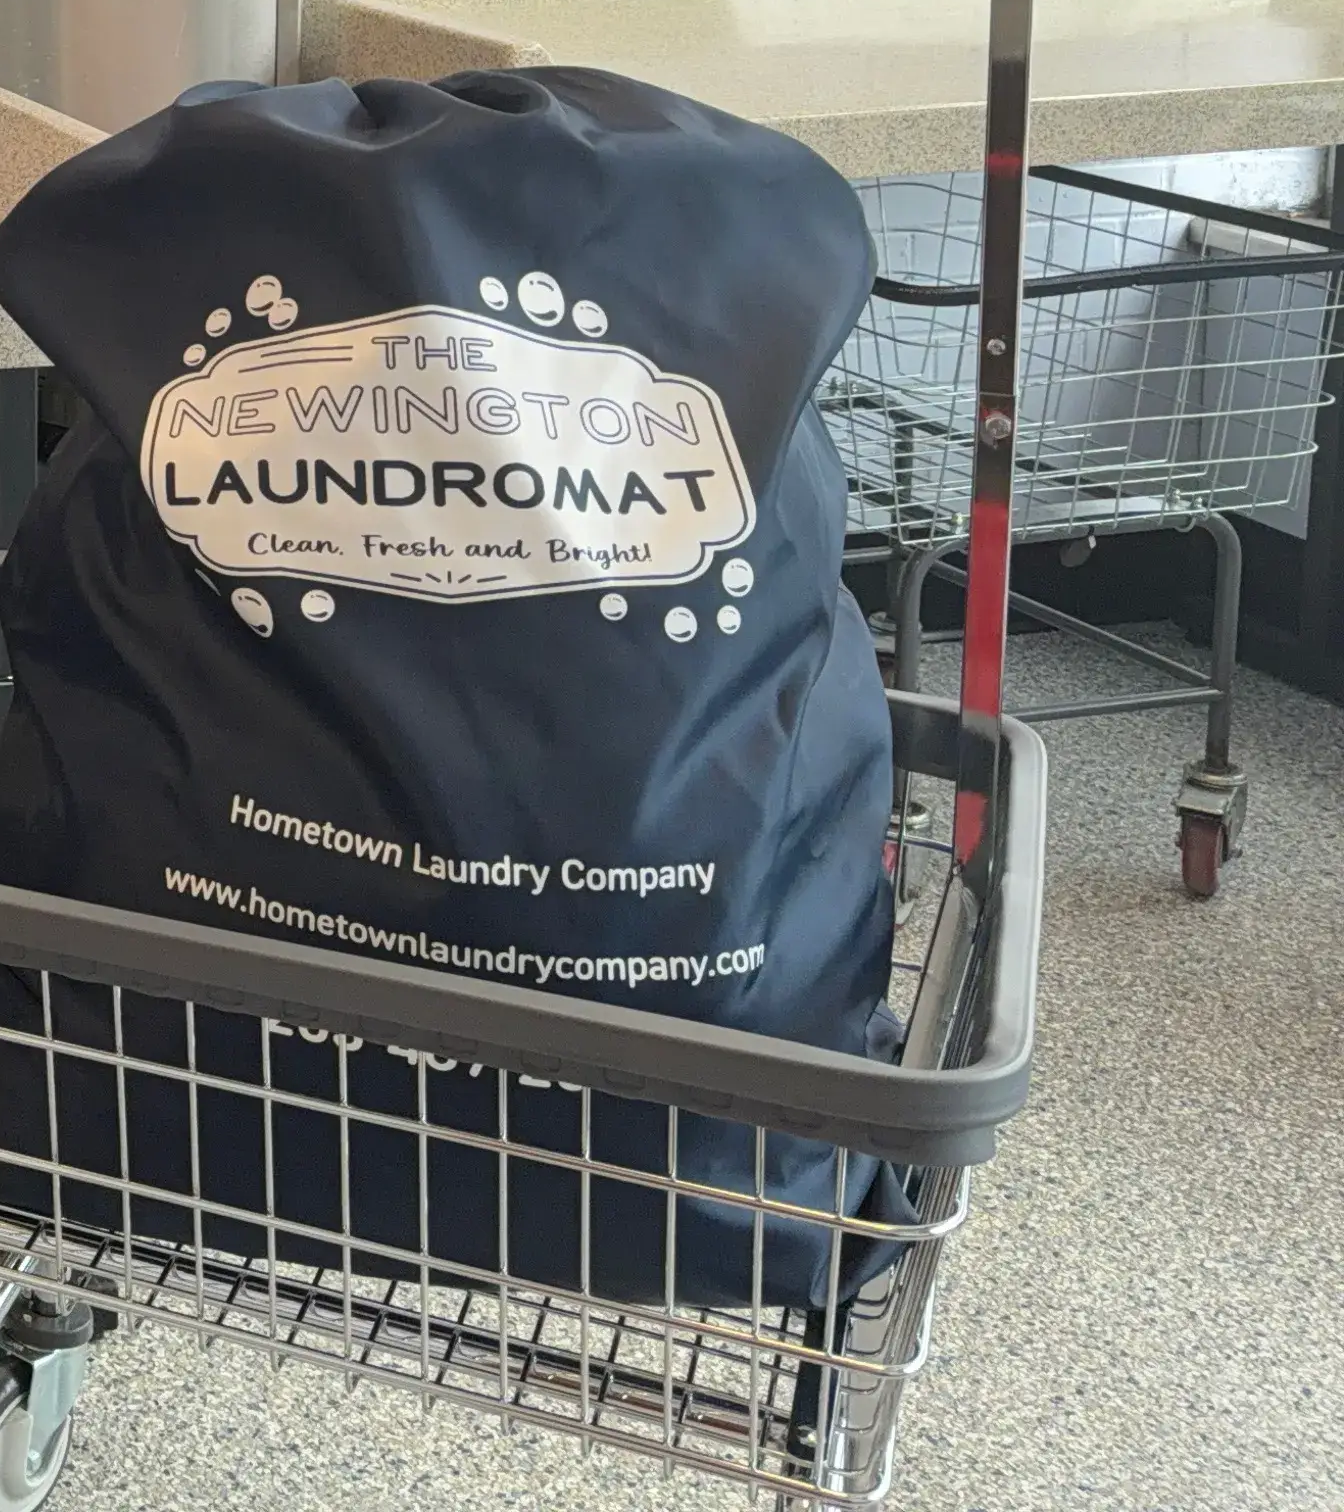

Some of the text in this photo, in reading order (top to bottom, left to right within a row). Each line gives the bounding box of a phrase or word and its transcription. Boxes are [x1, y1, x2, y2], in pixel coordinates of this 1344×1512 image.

[371, 336, 497, 371] THE
[168, 384, 701, 446] NEWINGTON
[165, 459, 715, 515] LAUNDROMAT
[361, 533, 454, 559] Fresh
[465, 534, 531, 561] and
[545, 537, 653, 571] Bright!
[229, 794, 715, 898] Hometown Laundry Company
[165, 864, 766, 988] www.hometownlaundrycompany.com
